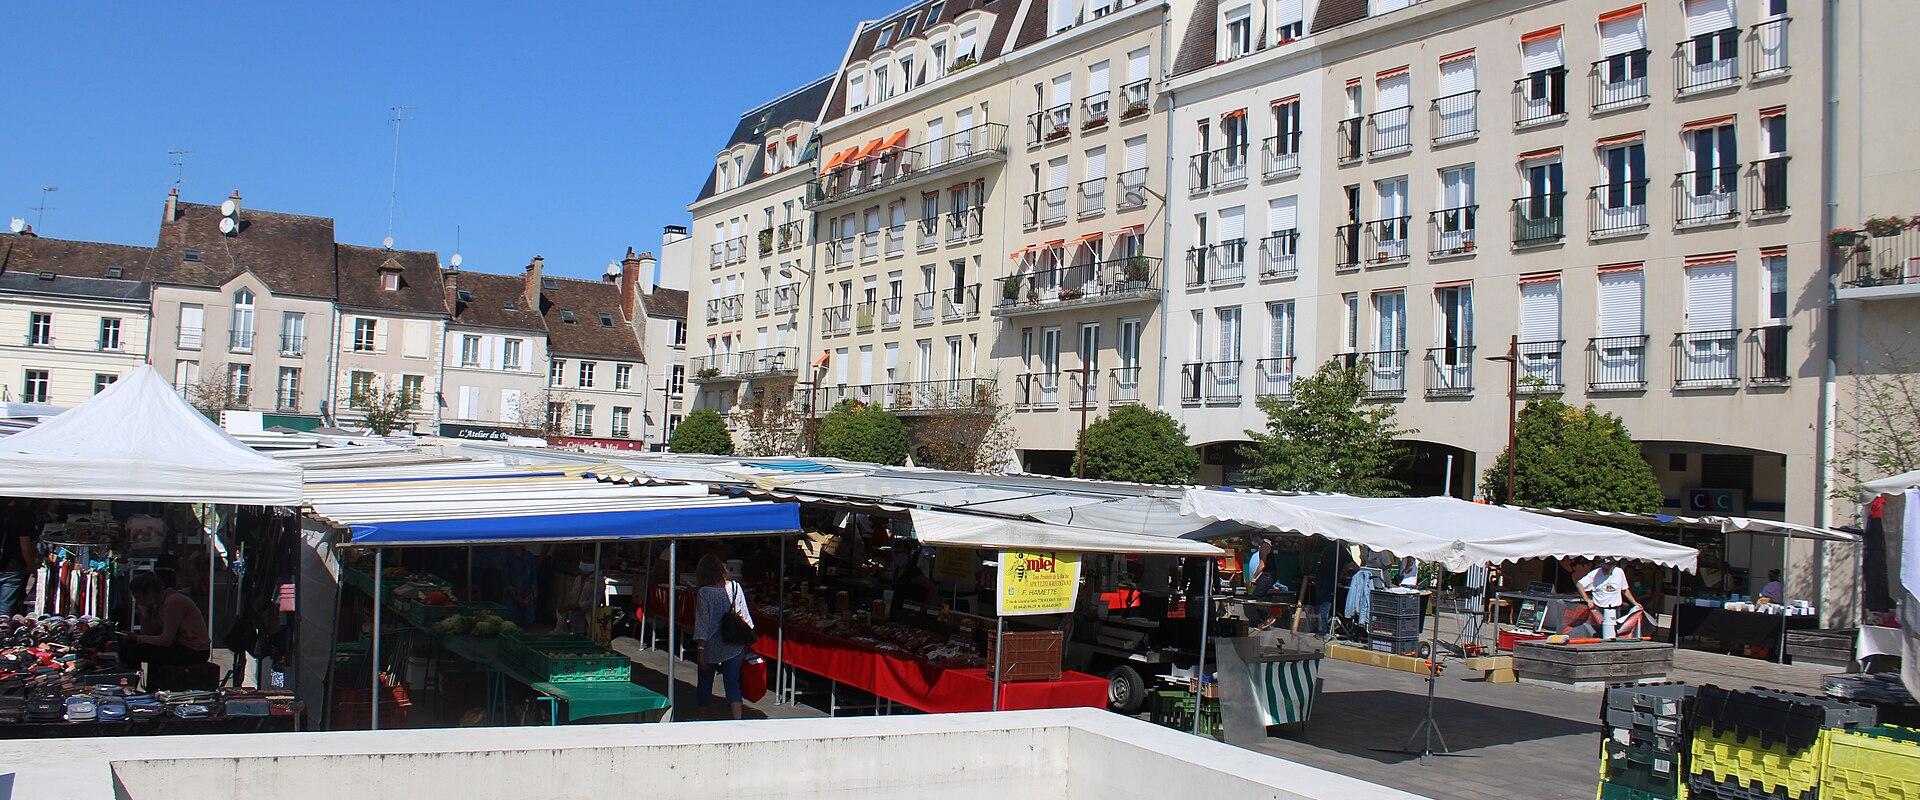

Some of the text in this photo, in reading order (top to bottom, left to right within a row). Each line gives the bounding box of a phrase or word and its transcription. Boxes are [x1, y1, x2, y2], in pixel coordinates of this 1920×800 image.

[458, 429, 490, 438] L'Atelier
[489, 430, 499, 439] du
[1694, 494, 1729, 509] CIC
[1026, 551, 1056, 573] miel
